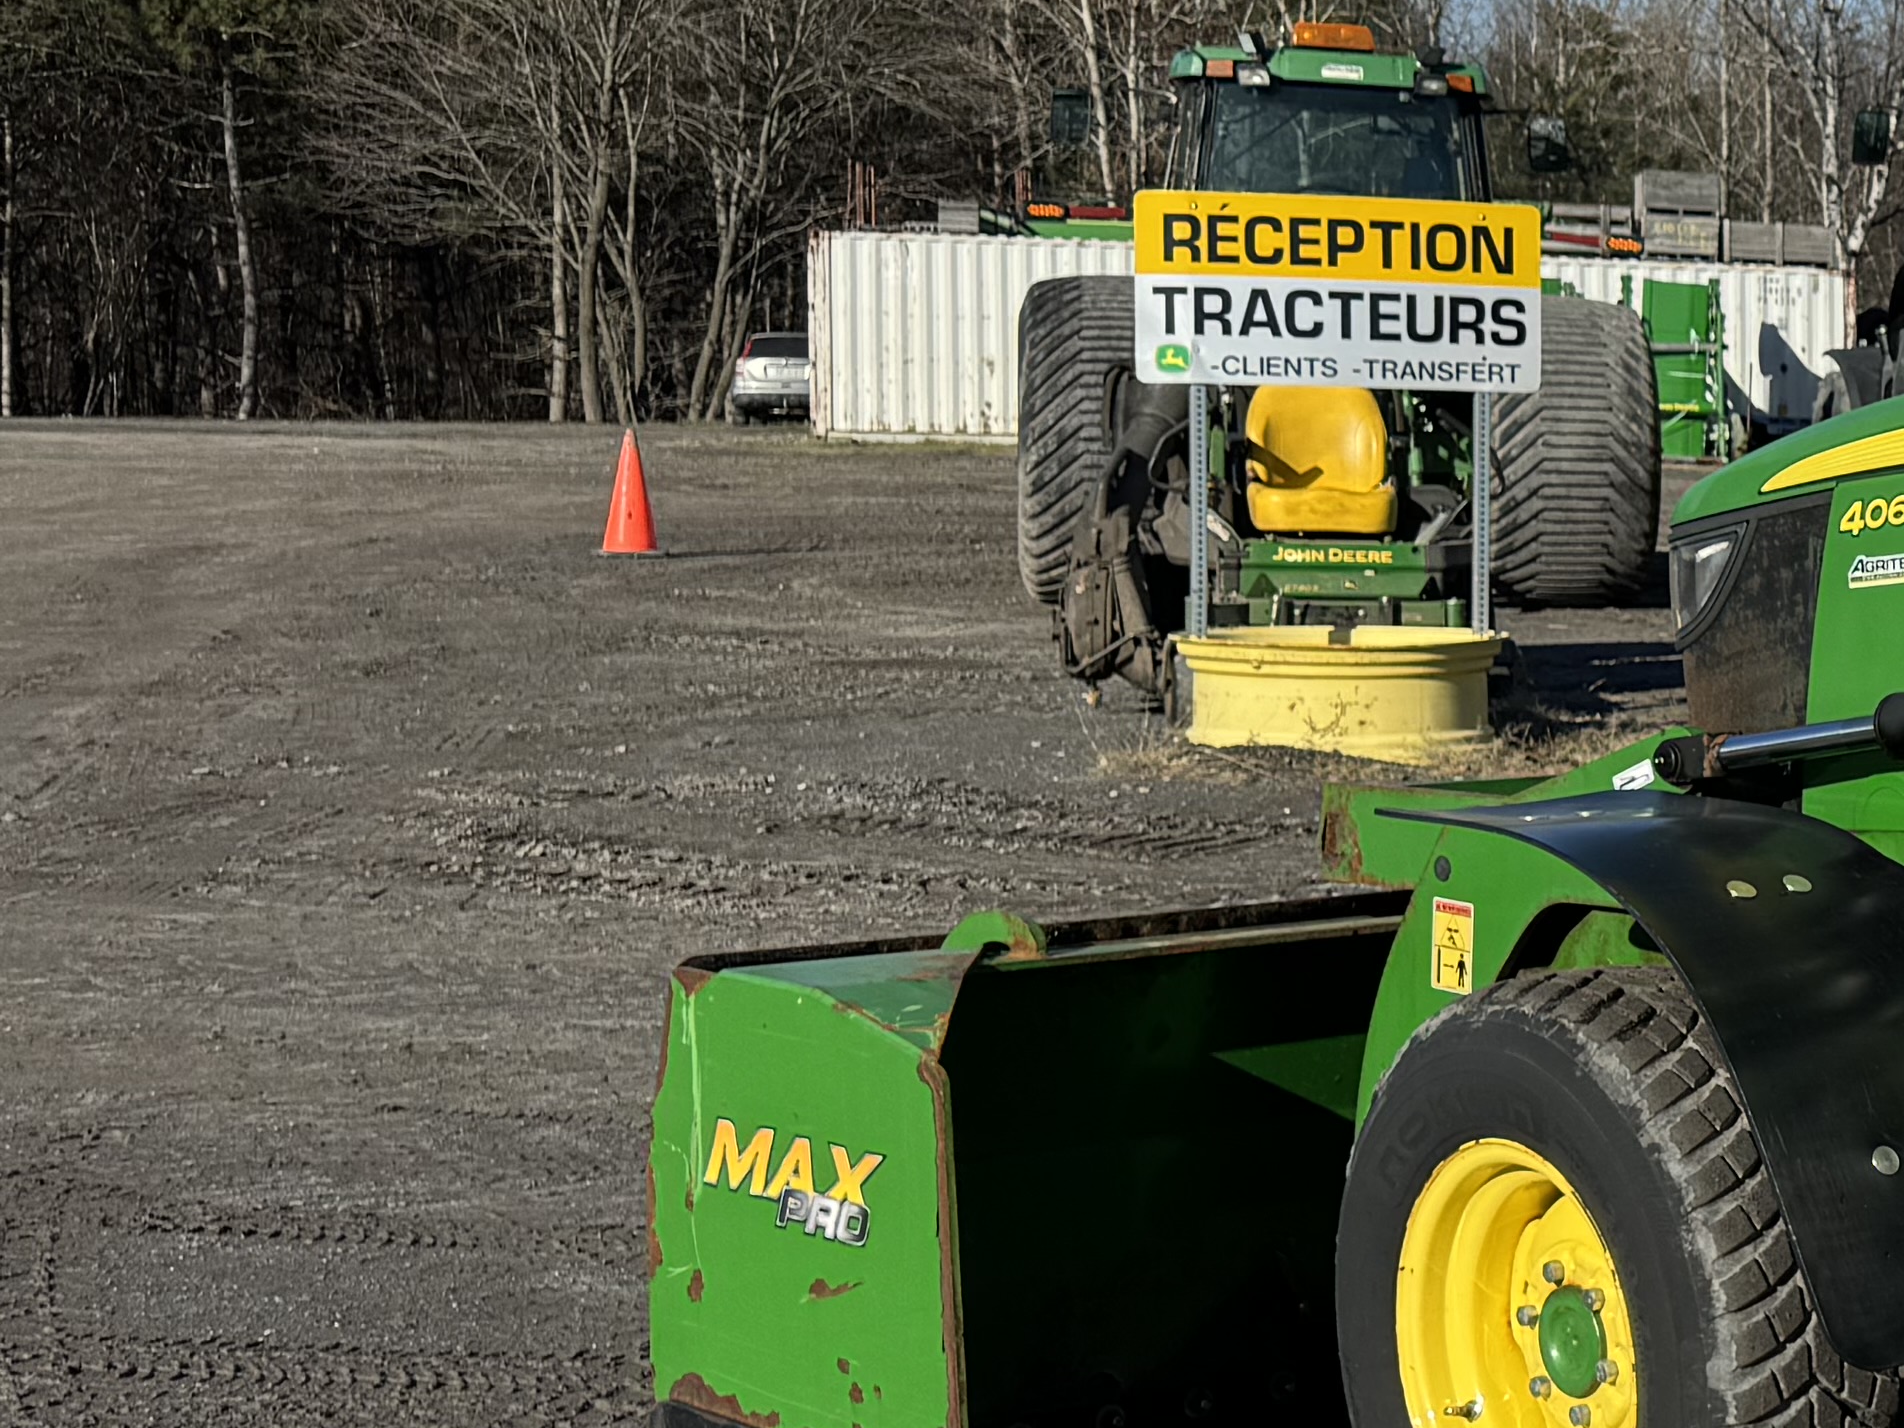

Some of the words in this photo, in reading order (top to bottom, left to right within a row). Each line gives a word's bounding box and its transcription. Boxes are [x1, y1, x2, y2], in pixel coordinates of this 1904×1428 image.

[1153, 286, 1527, 346] TRACTEURS
[1272, 546, 1325, 563] JOHN
[1328, 548, 1393, 564] DEERE
[703, 1116, 887, 1206] MAX
[775, 1184, 872, 1247] PRO
